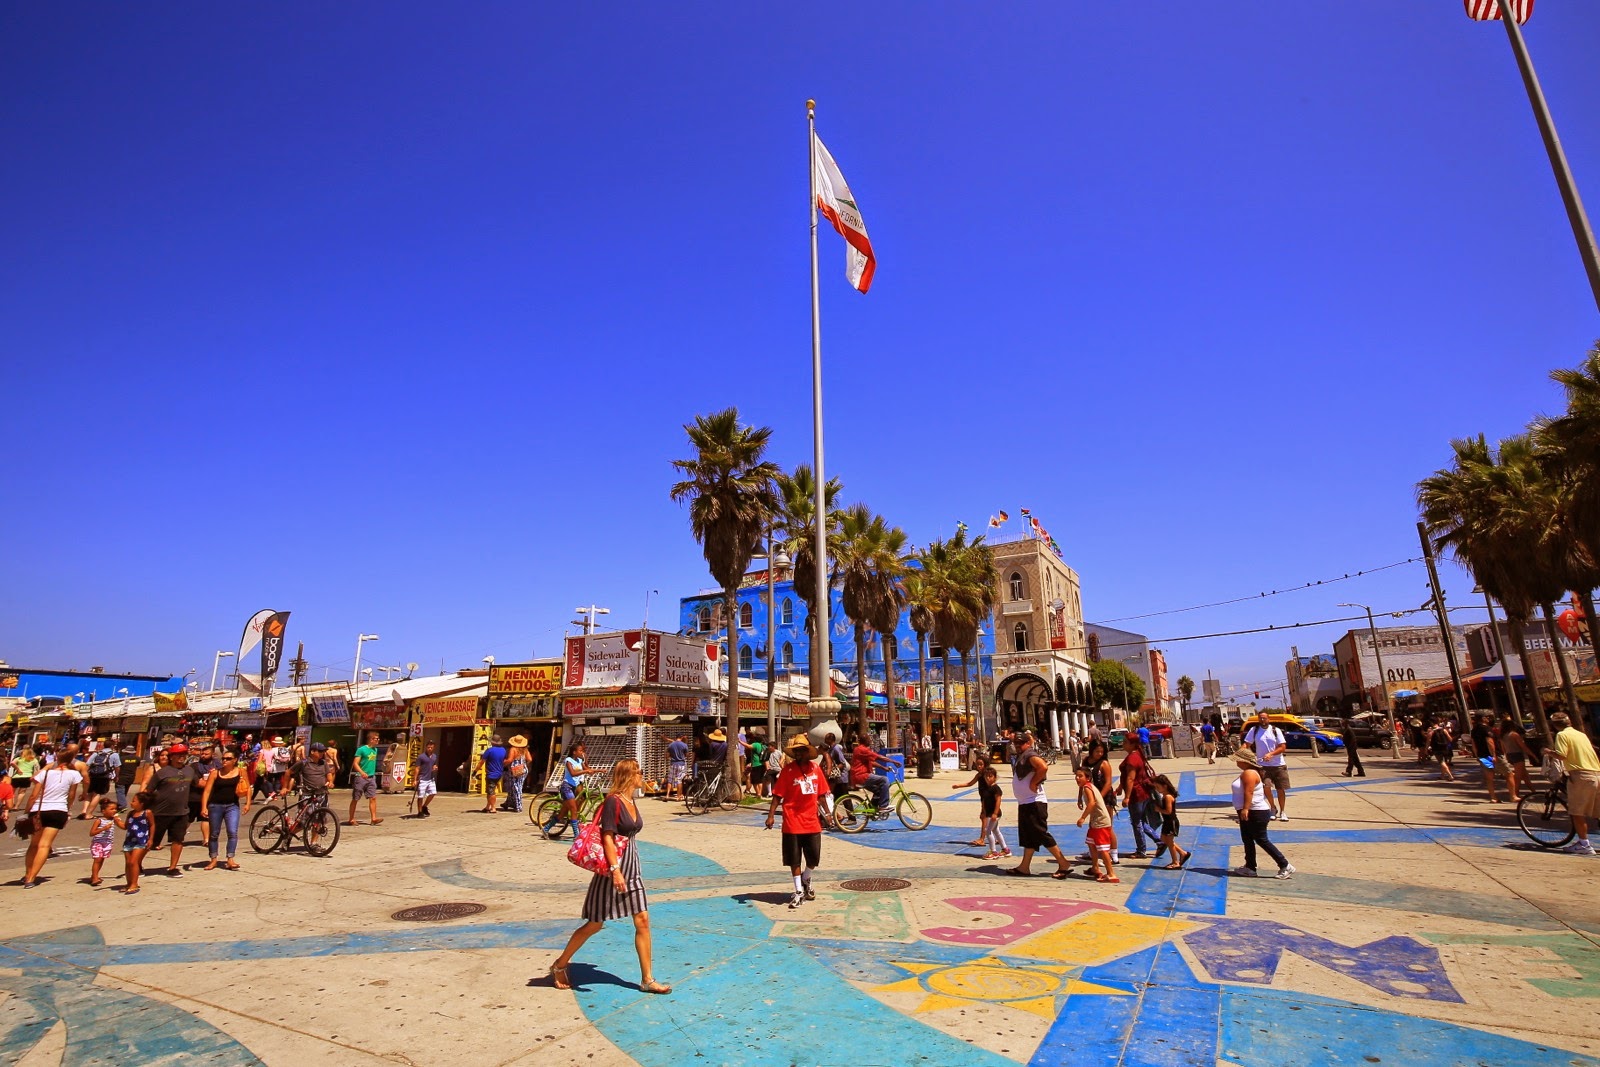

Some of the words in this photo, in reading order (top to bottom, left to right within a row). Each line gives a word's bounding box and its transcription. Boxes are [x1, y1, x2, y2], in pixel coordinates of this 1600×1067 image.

[1566, 613, 1578, 634] ATM
[267, 637, 280, 672] boost
[588, 648, 631, 661] Sidewalk
[648, 636, 658, 678] VENICE
[570, 640, 580, 684] VENICE
[588, 662, 621, 673] Market
[665, 654, 709, 672] Sidewalk
[1002, 657, 1040, 667] DANNY'S
[504, 670, 546, 680] HENNA
[553, 667, 560, 678] 2
[665, 669, 701, 684] Market
[498, 680, 552, 692] TATTOOS
[320, 701, 346, 710] SEGWAY
[424, 702, 446, 714] VENICE
[446, 700, 476, 713] MASSAGE
[583, 697, 630, 709] SUNGLASSE
[740, 700, 769, 711] SUNGLASS
[321, 709, 347, 719] RENTALS
[411, 723, 422, 735] $5
[406, 735, 422, 785] ASSAGE
